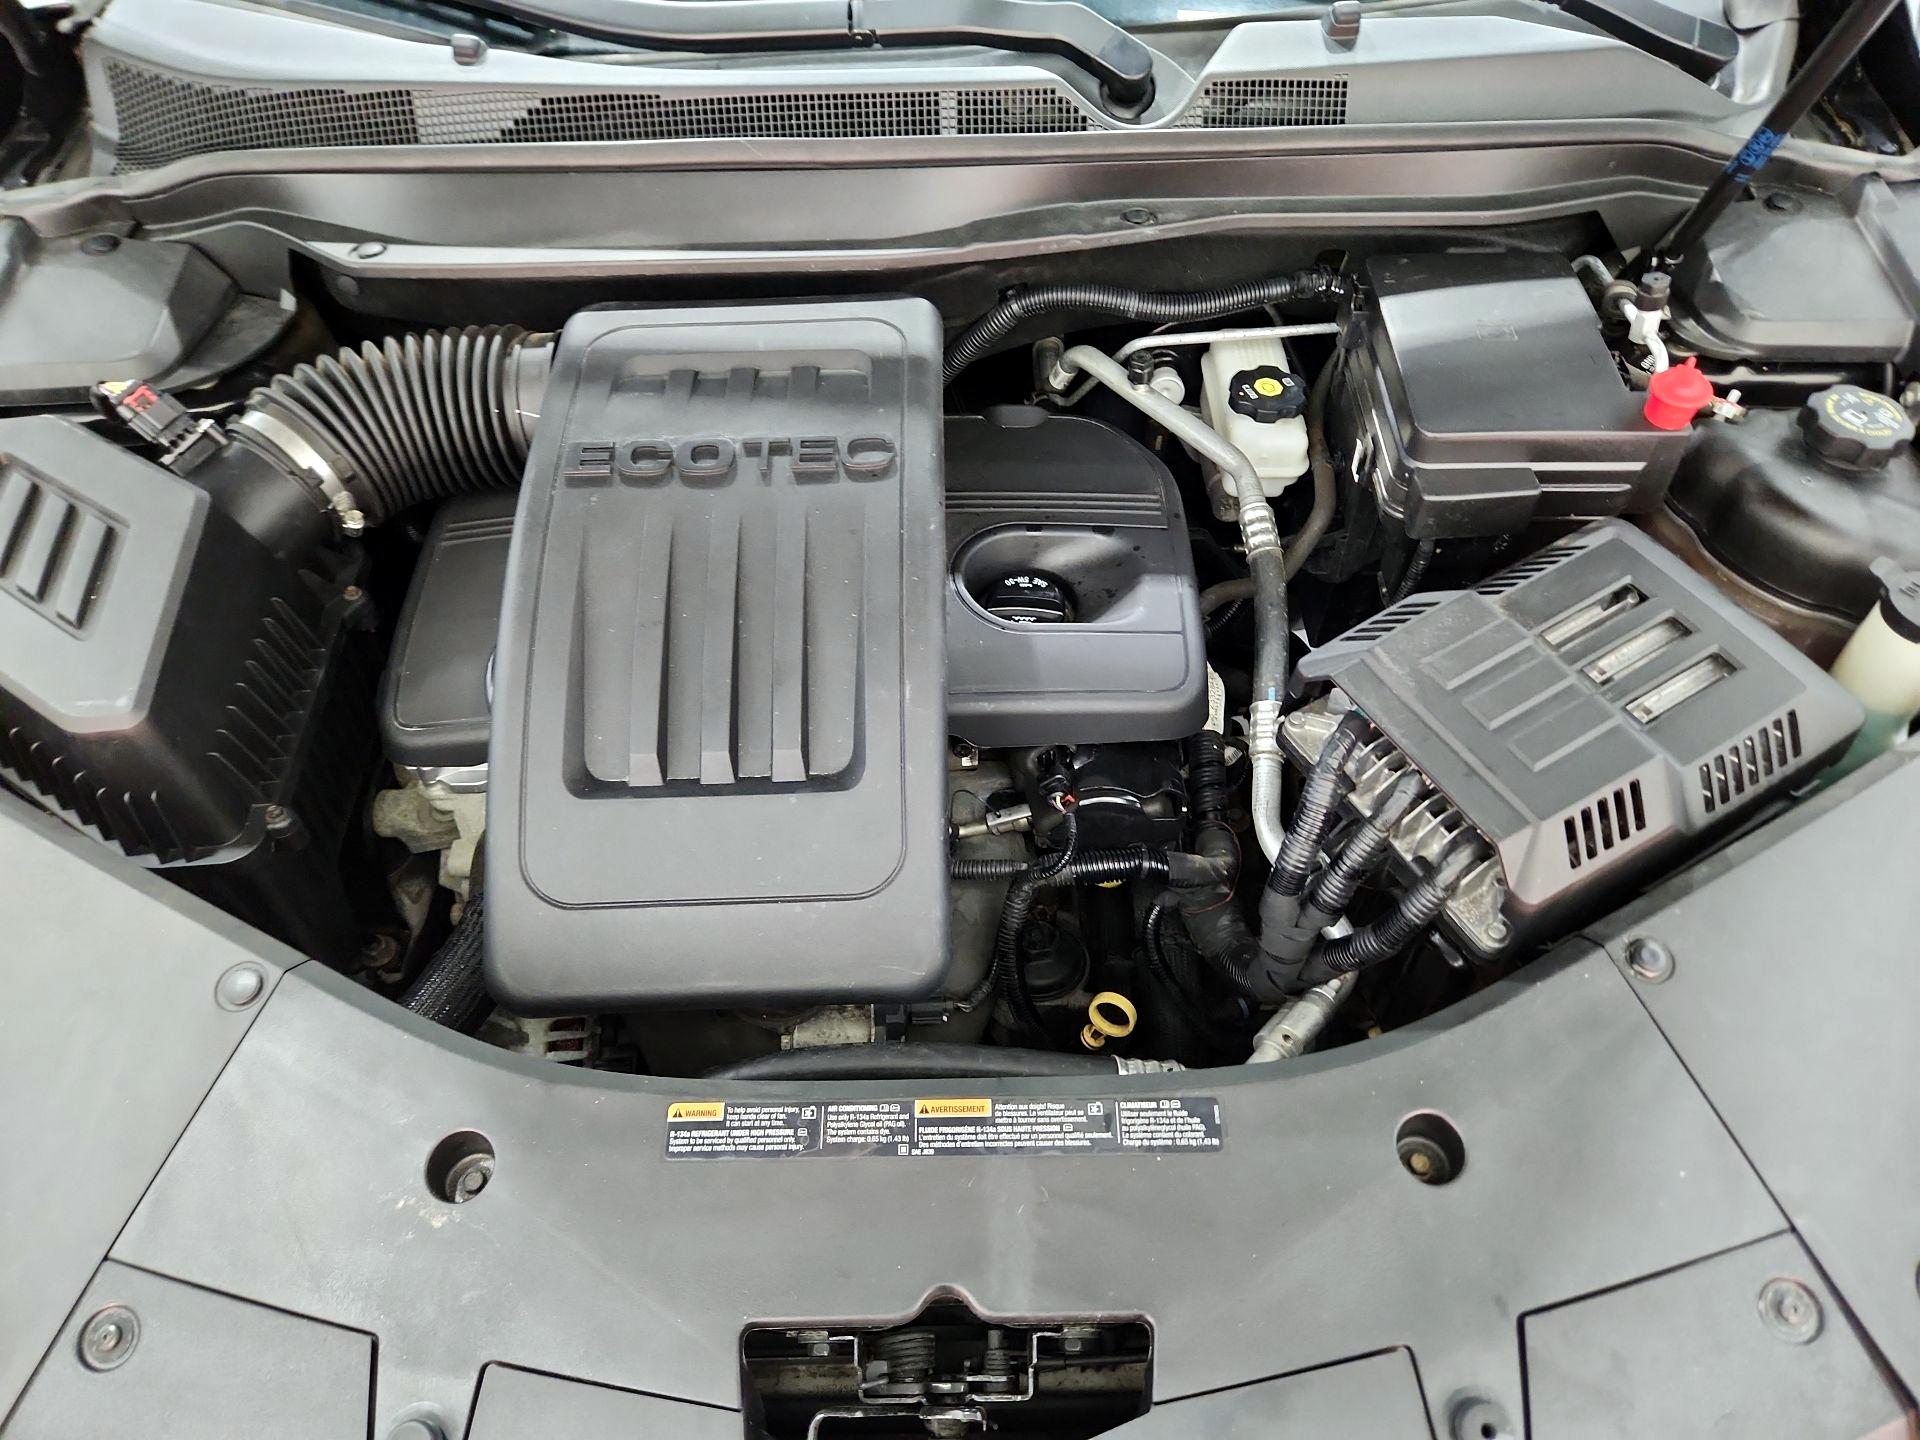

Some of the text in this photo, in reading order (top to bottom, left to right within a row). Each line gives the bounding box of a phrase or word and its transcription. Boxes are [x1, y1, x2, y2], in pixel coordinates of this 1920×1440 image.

[562, 436, 897, 480] ECOTEC
[1032, 577, 1048, 588] SAE
[686, 1109, 718, 1117] WARNING
[734, 1107, 746, 1115] help
[761, 1106, 784, 1114] personal
[931, 1105, 985, 1113] AVERTISSEMENT
[870, 1113, 898, 1121] Refrigerant
[735, 1137, 757, 1145] qualified
[827, 1136, 845, 1144] System
[669, 1145, 692, 1153] Improper
[736, 1144, 748, 1152] may
